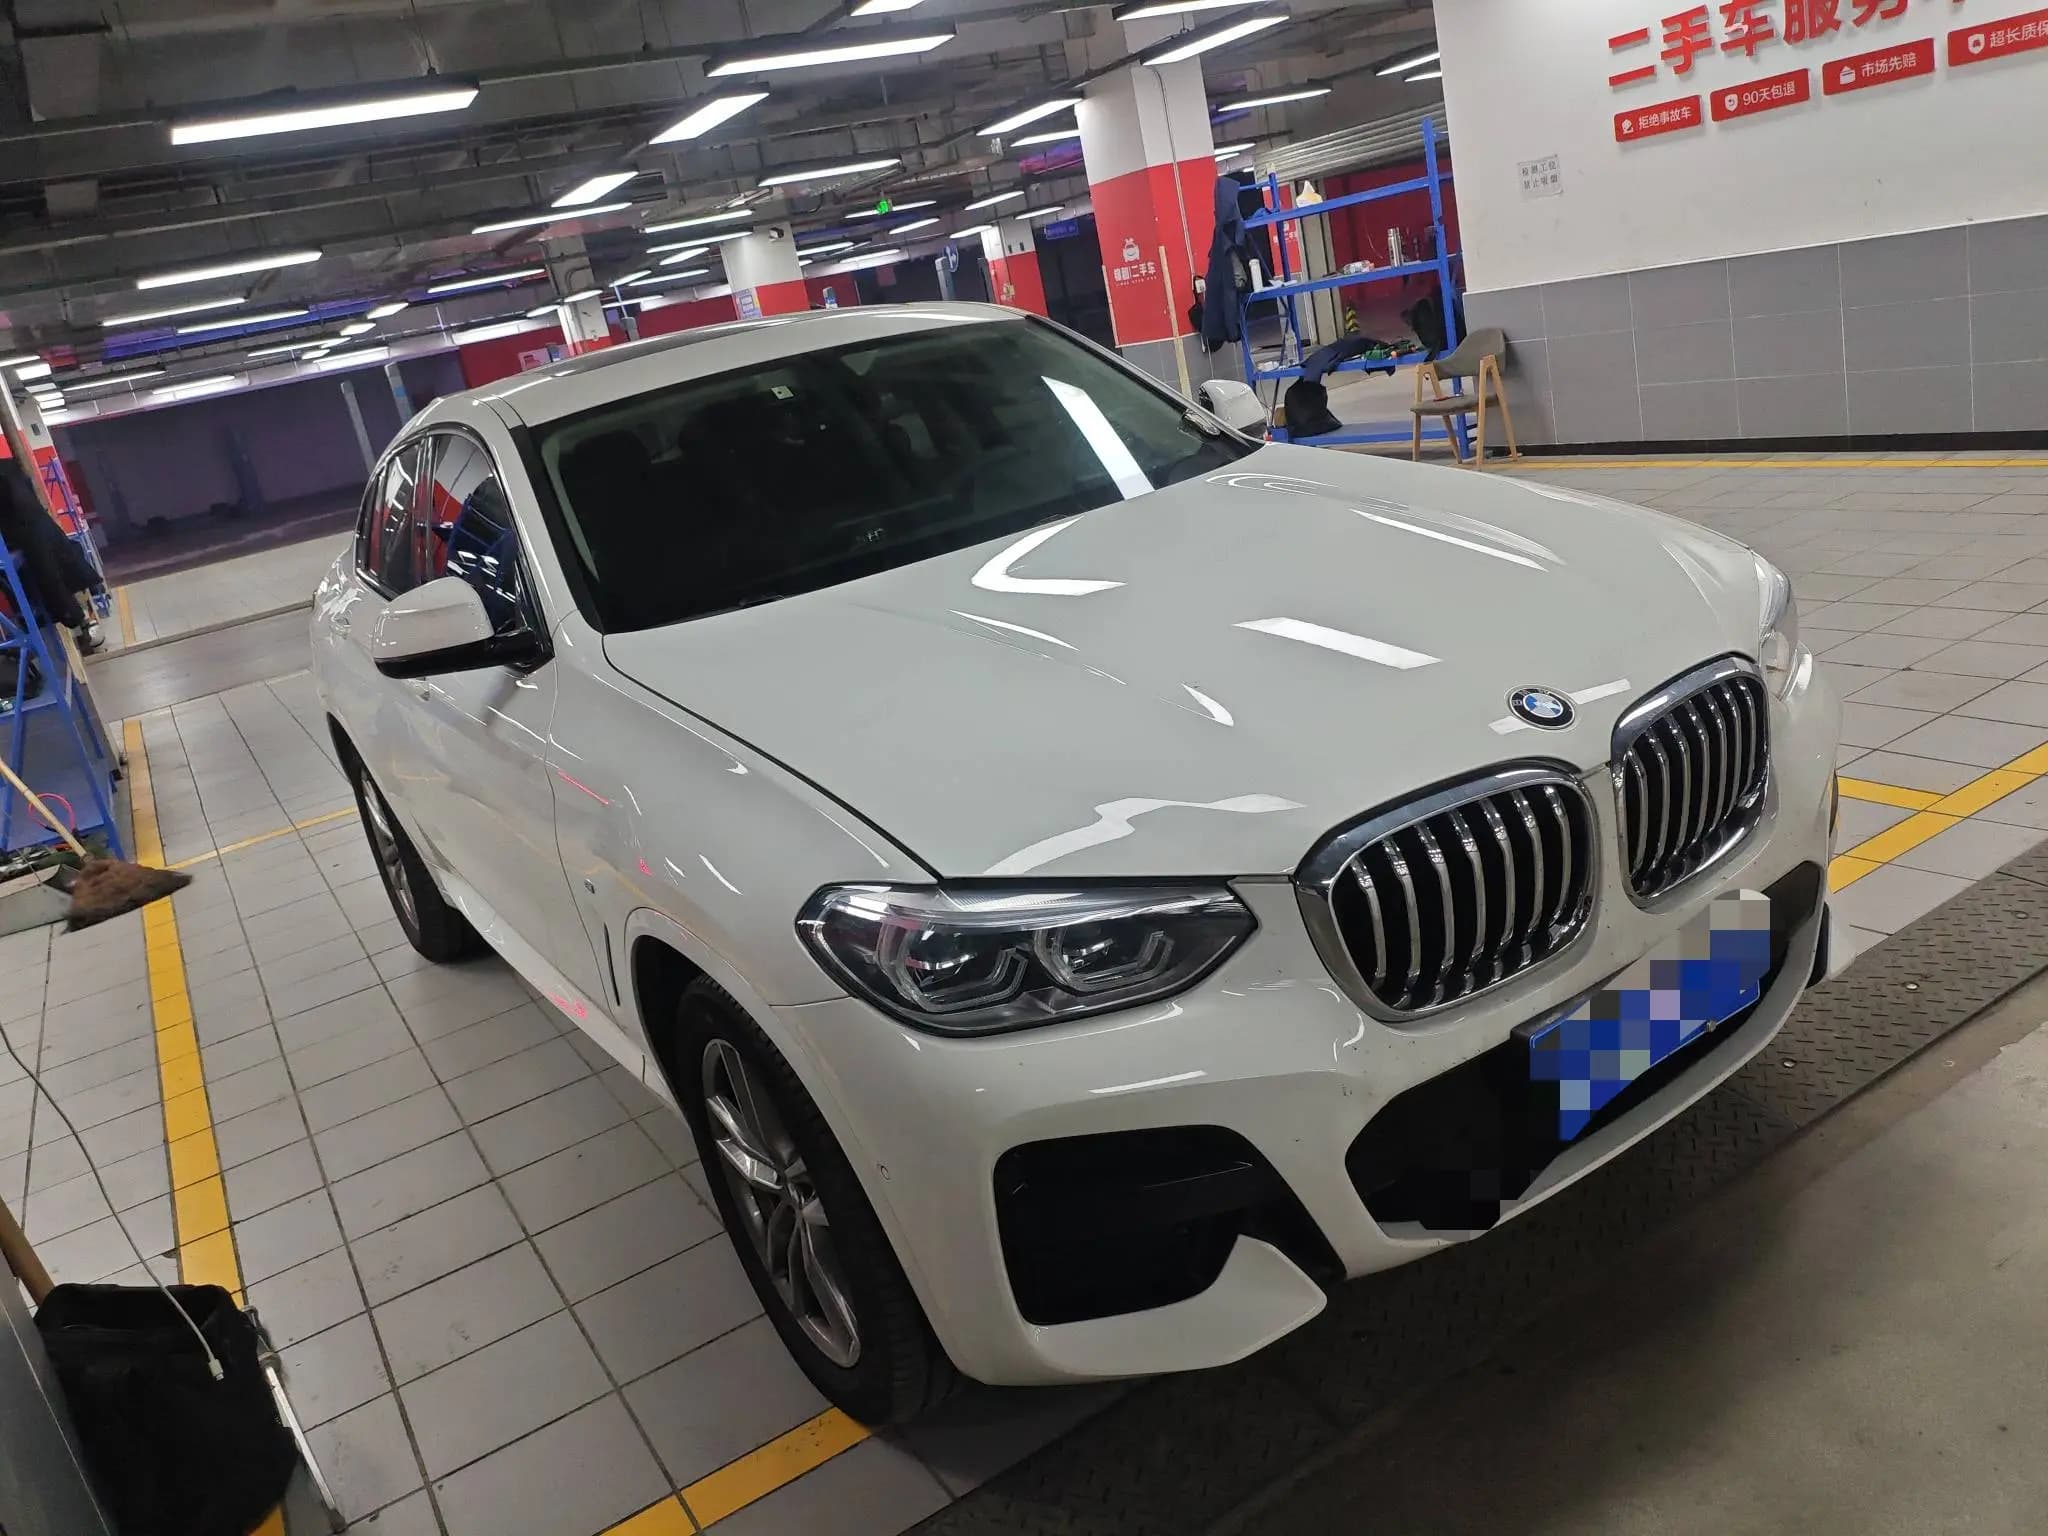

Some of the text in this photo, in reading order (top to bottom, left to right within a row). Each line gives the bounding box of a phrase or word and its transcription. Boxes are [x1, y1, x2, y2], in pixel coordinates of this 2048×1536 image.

[1861, 52, 1917, 77] 市场先赔
[1743, 80, 1796, 105] 90天包退
[1638, 106, 1692, 129] 拒绝事故车
